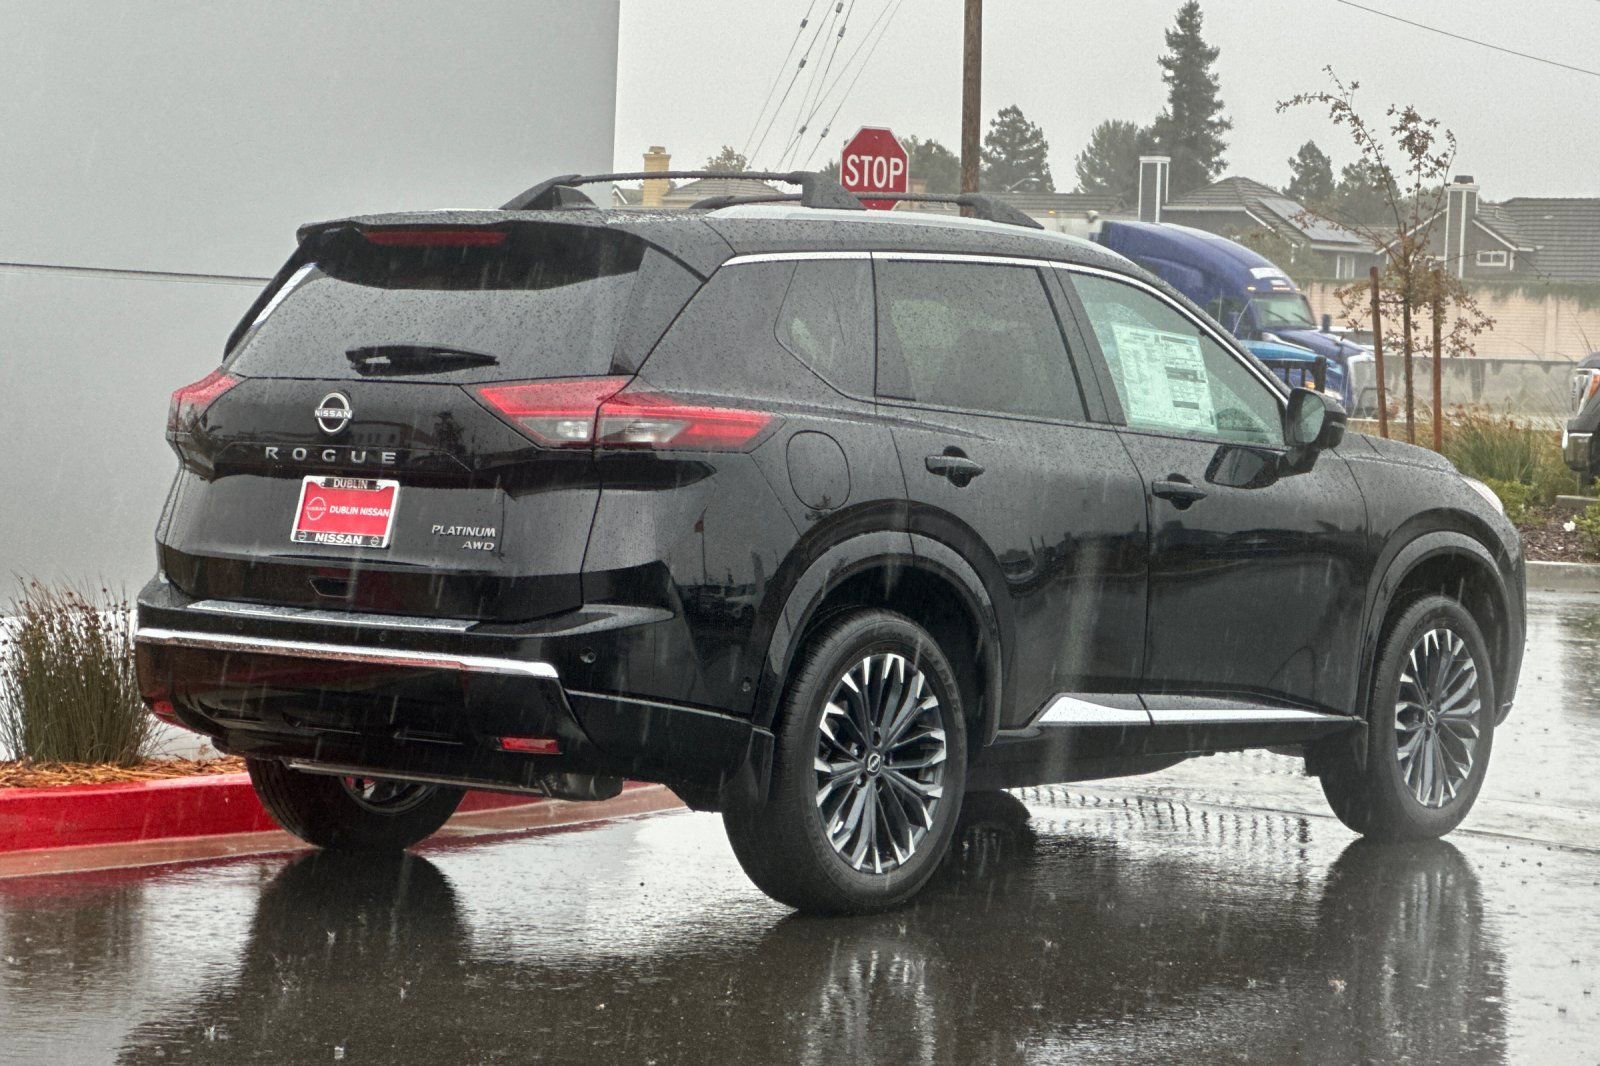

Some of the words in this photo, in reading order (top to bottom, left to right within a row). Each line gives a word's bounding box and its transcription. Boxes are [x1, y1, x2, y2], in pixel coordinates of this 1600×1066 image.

[845, 154, 904, 188] STOP
[315, 409, 352, 419] NISSAN
[265, 446, 396, 464] ROGUE
[333, 478, 368, 489] DUBLIN
[329, 505, 359, 515] DUBLIN
[360, 507, 391, 517] NISSAN
[431, 524, 496, 537] PLATINUM
[314, 533, 363, 544] NISSAN
[462, 541, 495, 551] AWD
